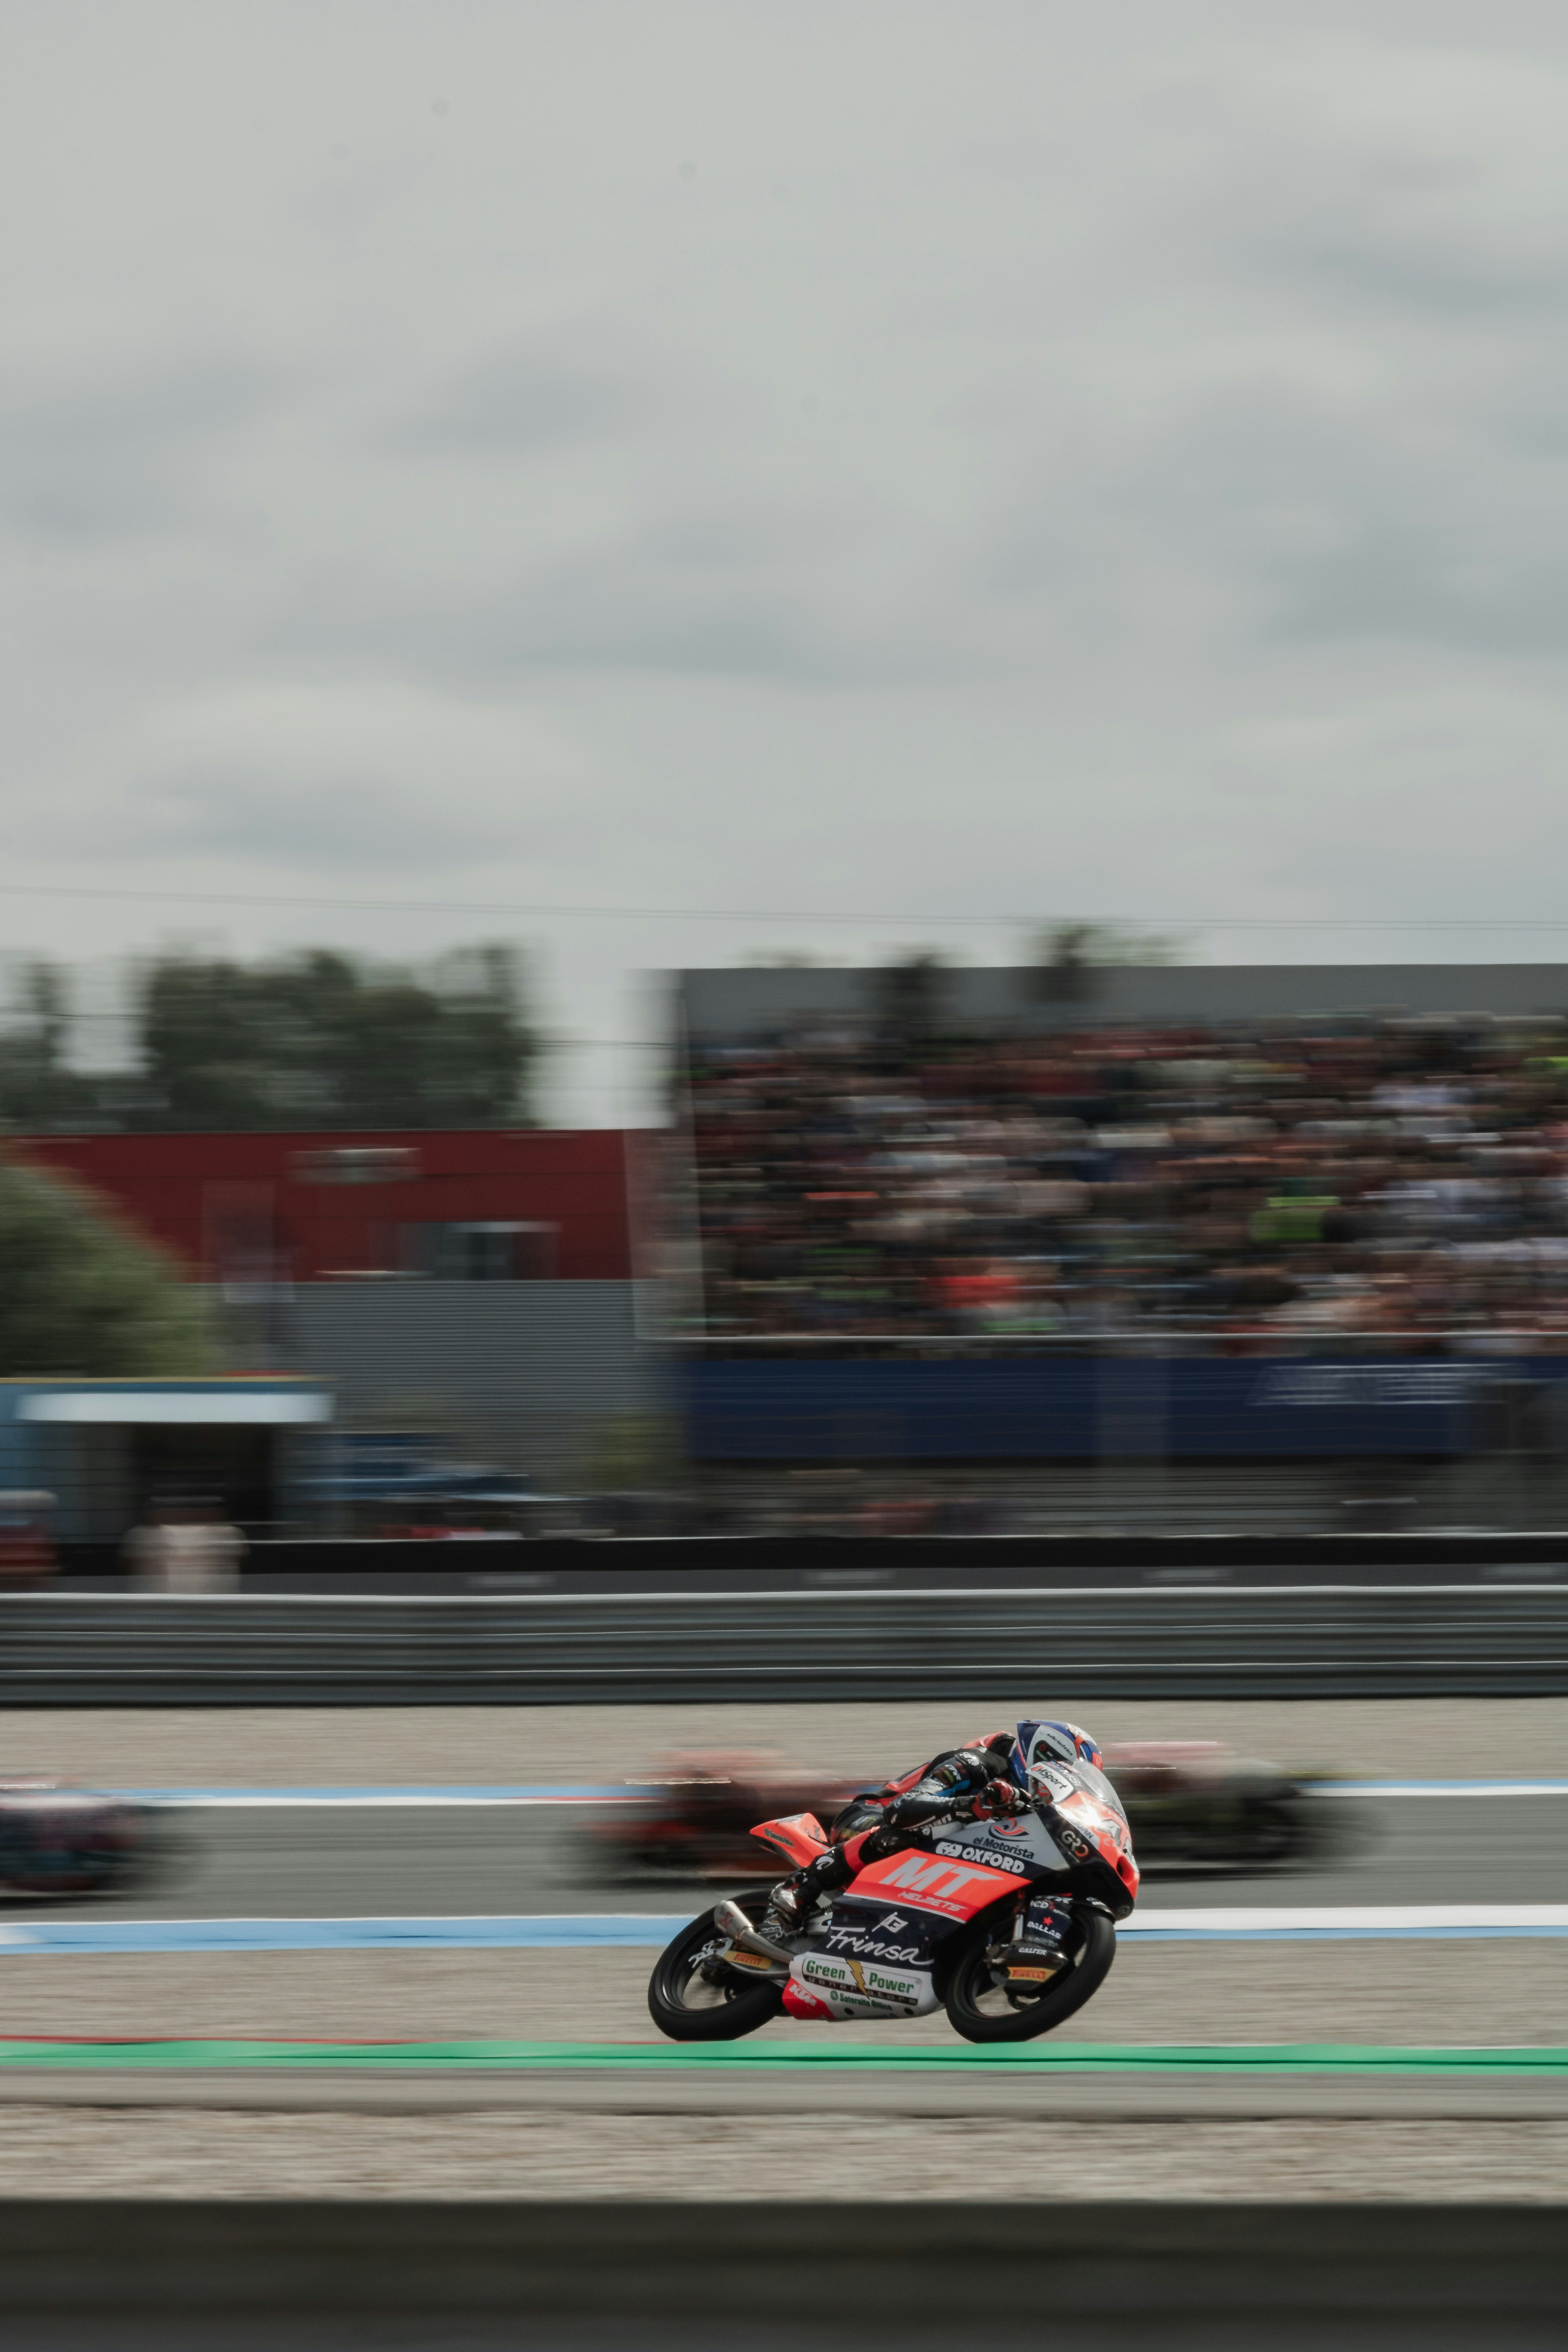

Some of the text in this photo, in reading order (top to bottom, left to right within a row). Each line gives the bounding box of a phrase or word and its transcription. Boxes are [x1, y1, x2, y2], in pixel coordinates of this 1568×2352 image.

[962, 1847, 1025, 1873] OXFORD
[983, 1838, 1035, 1860] Motorista
[878, 1856, 1005, 1898] MT
[898, 1891, 968, 1912] HELMETS
[826, 1926, 935, 1965] Frinsa
[806, 1960, 915, 1994] Green Power
